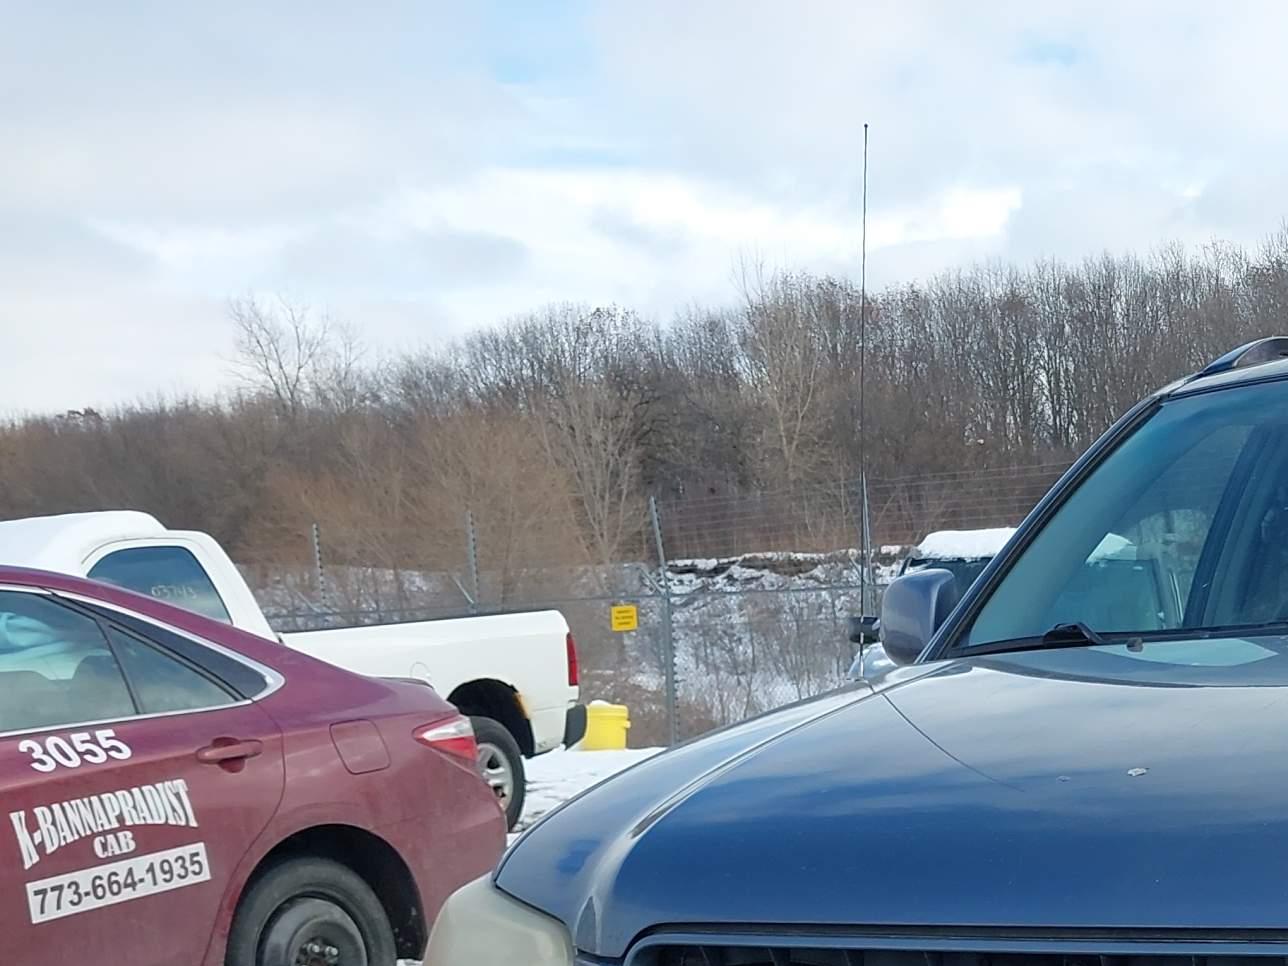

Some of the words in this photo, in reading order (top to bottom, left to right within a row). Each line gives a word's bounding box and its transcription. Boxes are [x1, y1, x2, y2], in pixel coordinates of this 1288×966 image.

[18, 728, 132, 773] 3055
[9, 778, 199, 870] K-BANNAPRADIST
[93, 830, 136, 859] CAB
[33, 851, 204, 915] 773-664-1935
